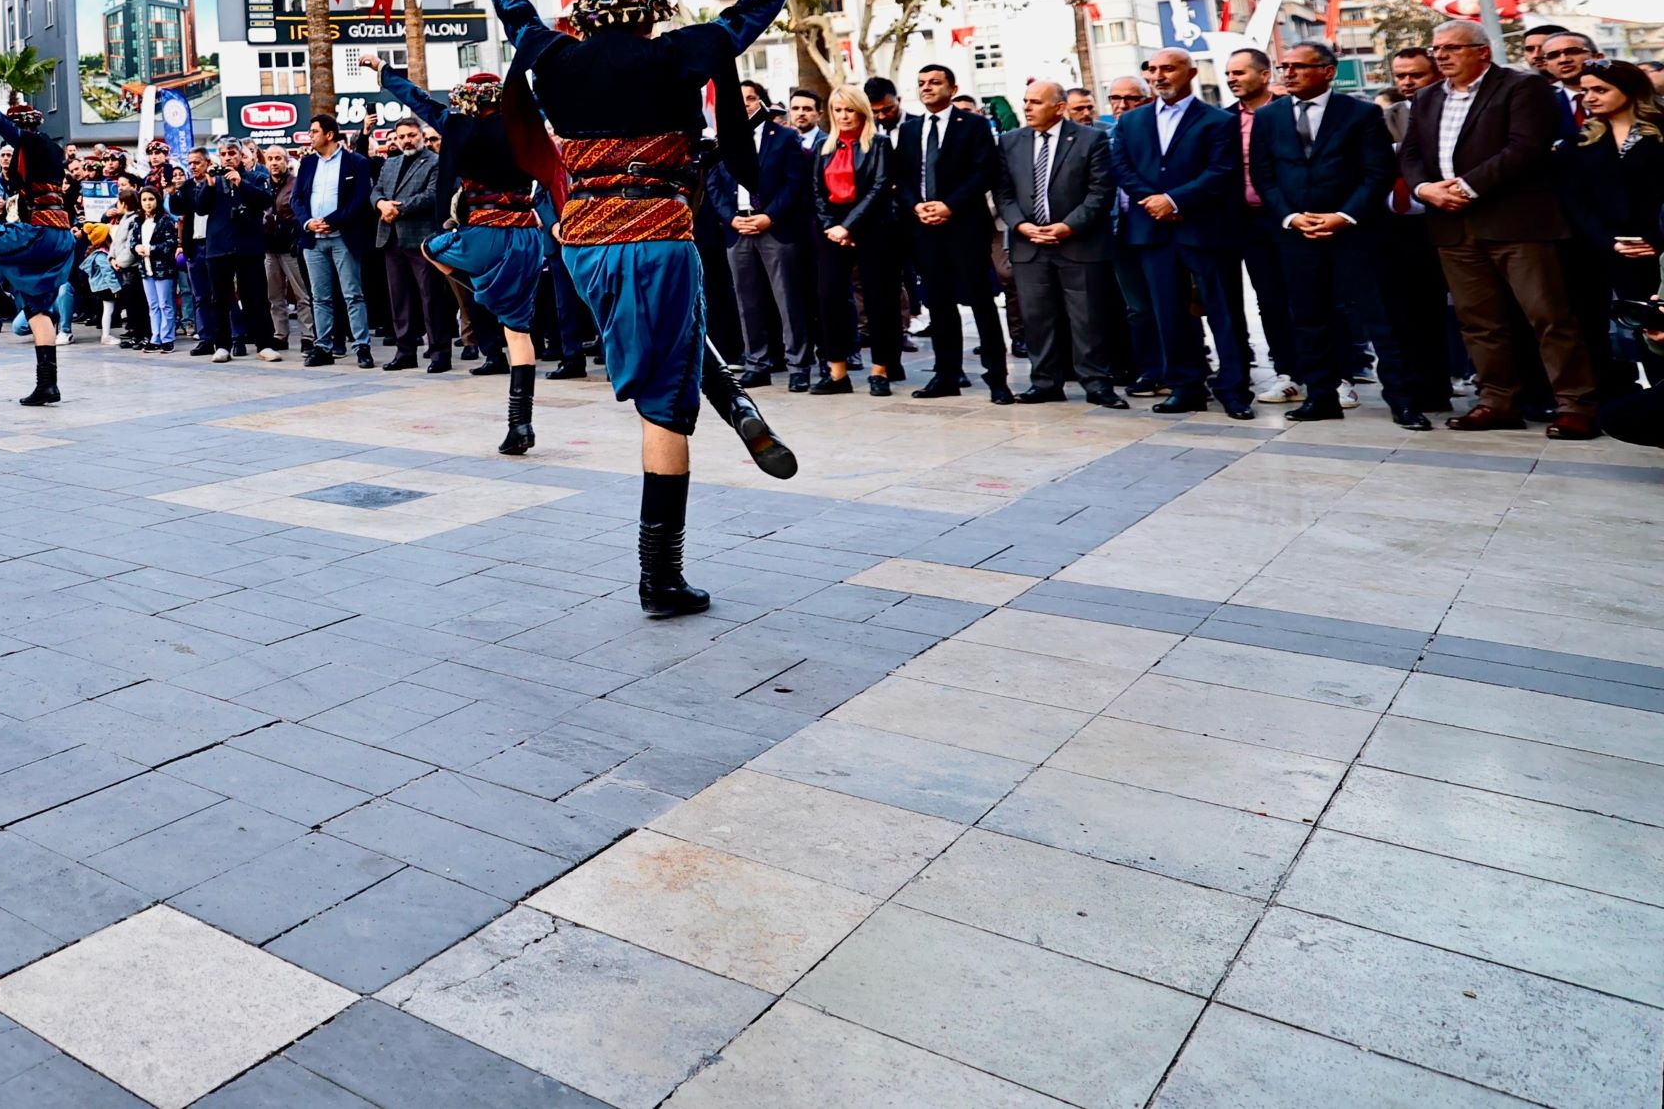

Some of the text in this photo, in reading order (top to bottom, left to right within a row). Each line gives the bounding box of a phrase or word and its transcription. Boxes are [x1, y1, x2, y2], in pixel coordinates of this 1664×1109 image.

[289, 22, 468, 40] IRS GÜZELLİK ALONU
[246, 106, 291, 123] Torku
[334, 96, 412, 127] döer
